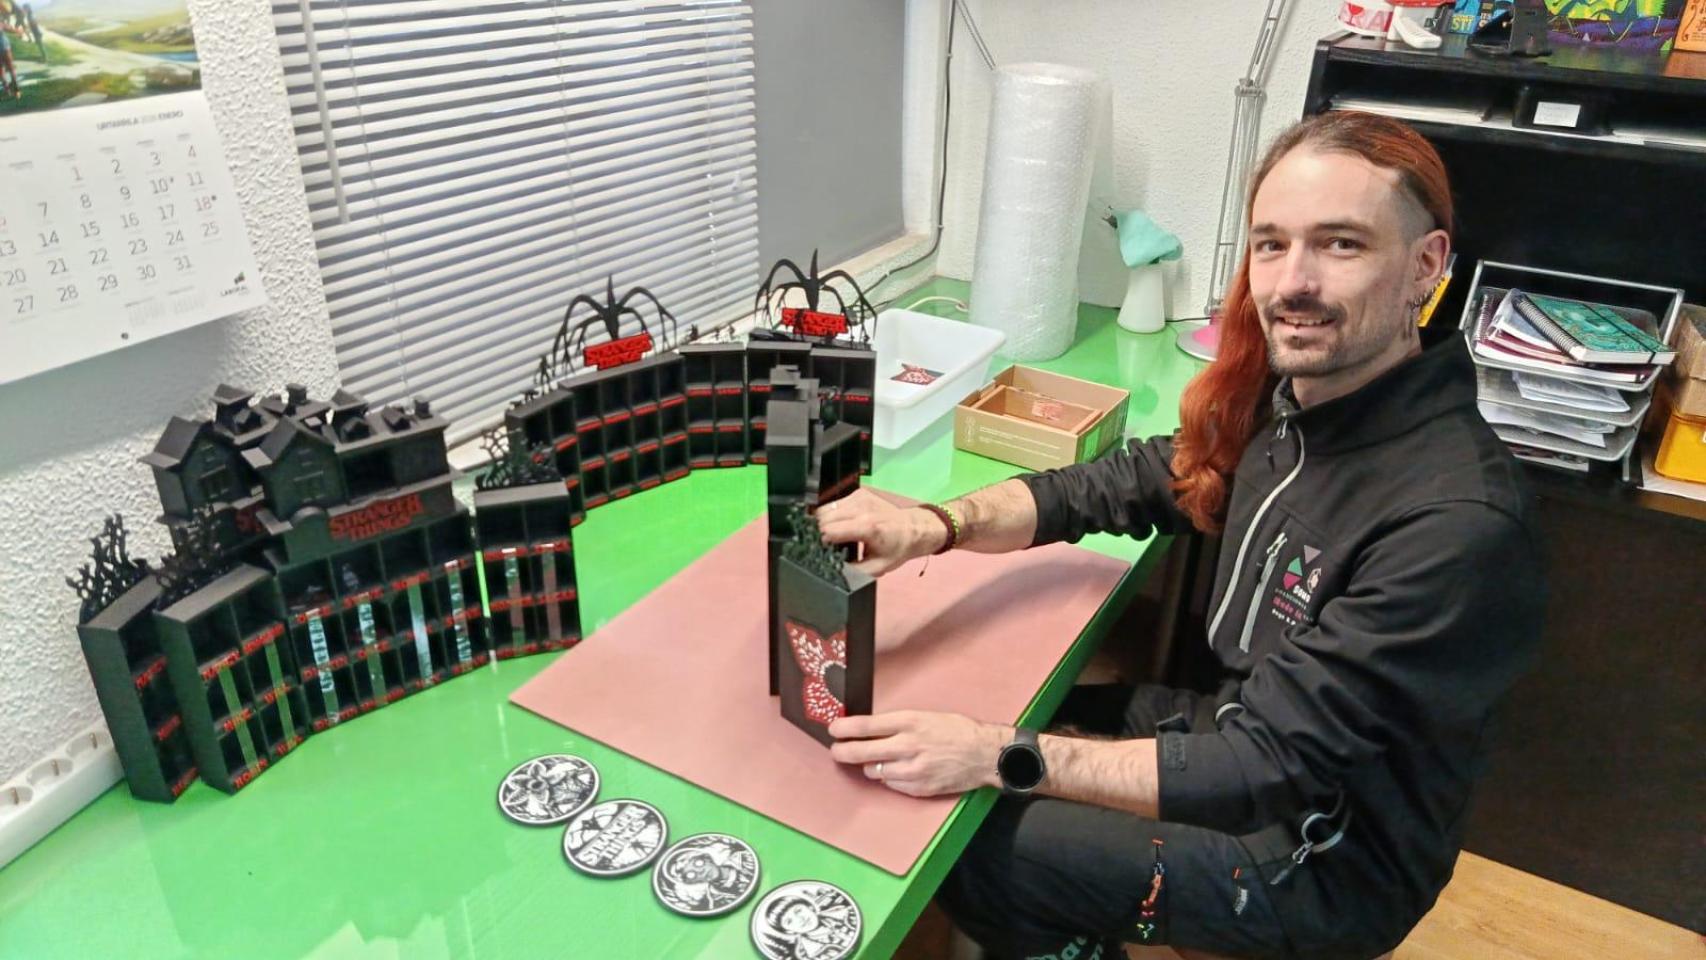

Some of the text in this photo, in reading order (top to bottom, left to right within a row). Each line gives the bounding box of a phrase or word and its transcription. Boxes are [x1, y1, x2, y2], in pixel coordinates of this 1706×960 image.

[71, 144, 197, 181] 1 2 3 4
[37, 172, 204, 218] 7 8 9 10 11
[38, 230, 60, 248] 14
[80, 221, 101, 238] 15
[120, 212, 141, 229] 16
[158, 204, 175, 221] 17
[194, 196, 212, 212] 18
[4, 221, 220, 286] 20 21 22 23 24 25
[14, 255, 193, 314] 27 28 29 30 31
